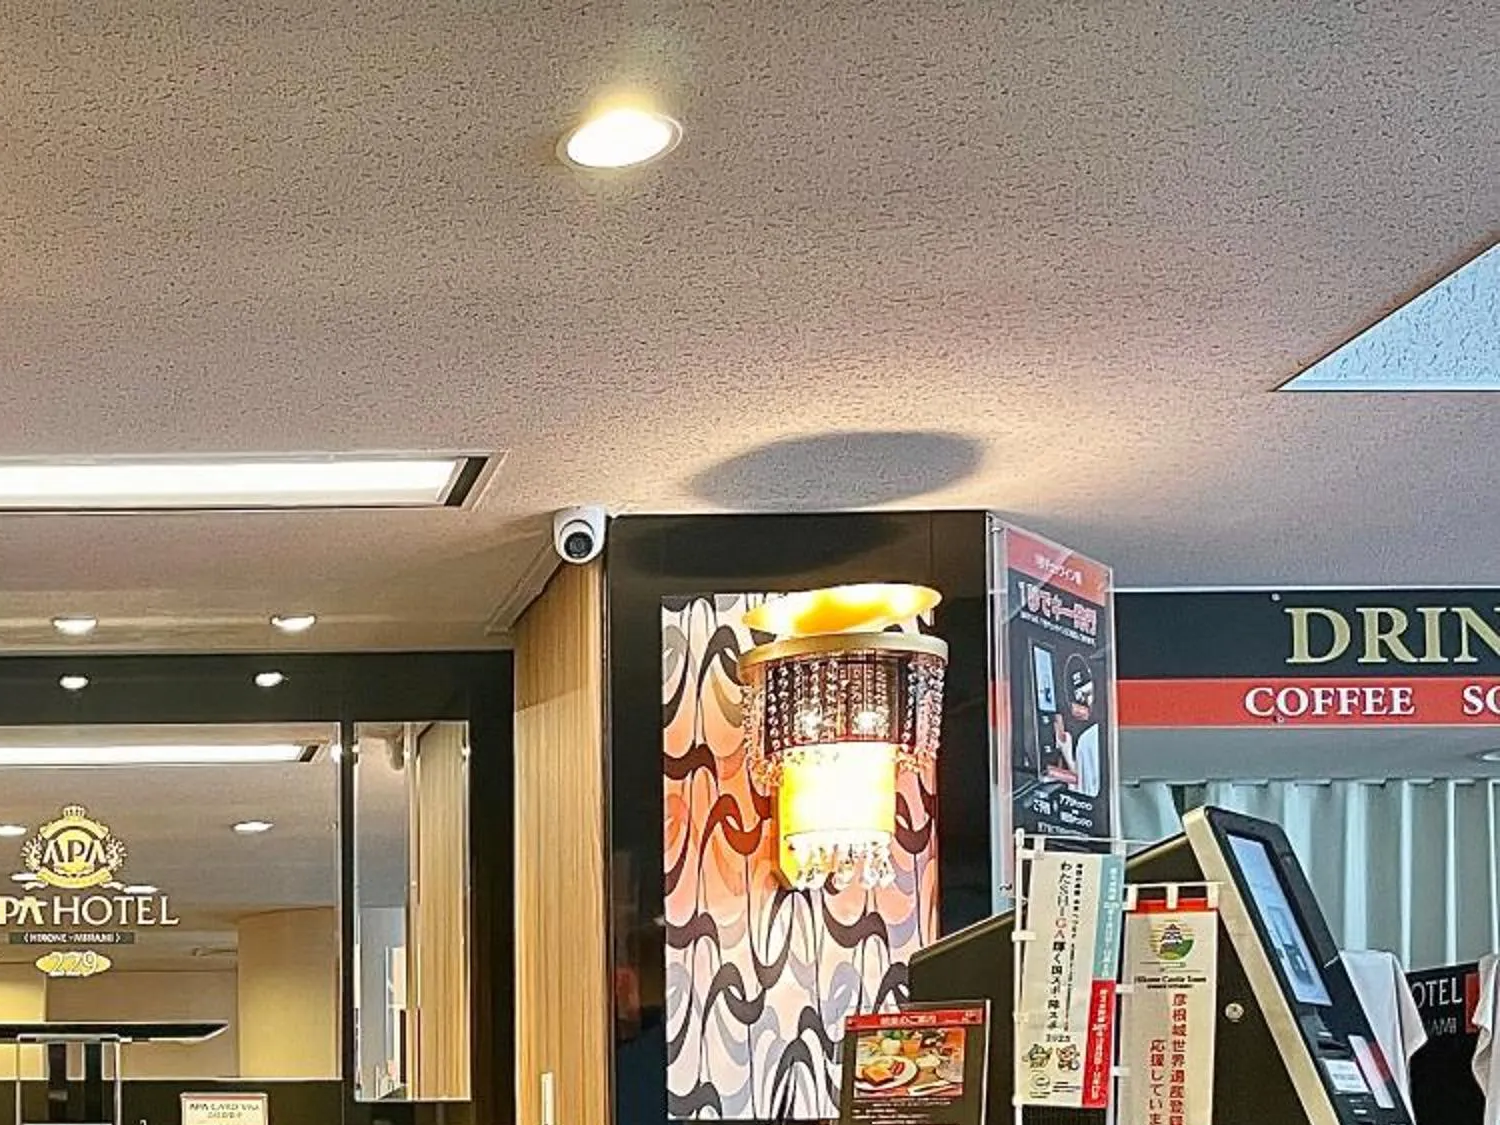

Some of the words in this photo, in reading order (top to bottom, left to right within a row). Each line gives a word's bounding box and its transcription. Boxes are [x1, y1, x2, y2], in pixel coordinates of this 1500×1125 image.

[1244, 687, 1416, 716] COFFEE
[42, 838, 108, 864] APA
[52, 895, 181, 926] HOTEL
